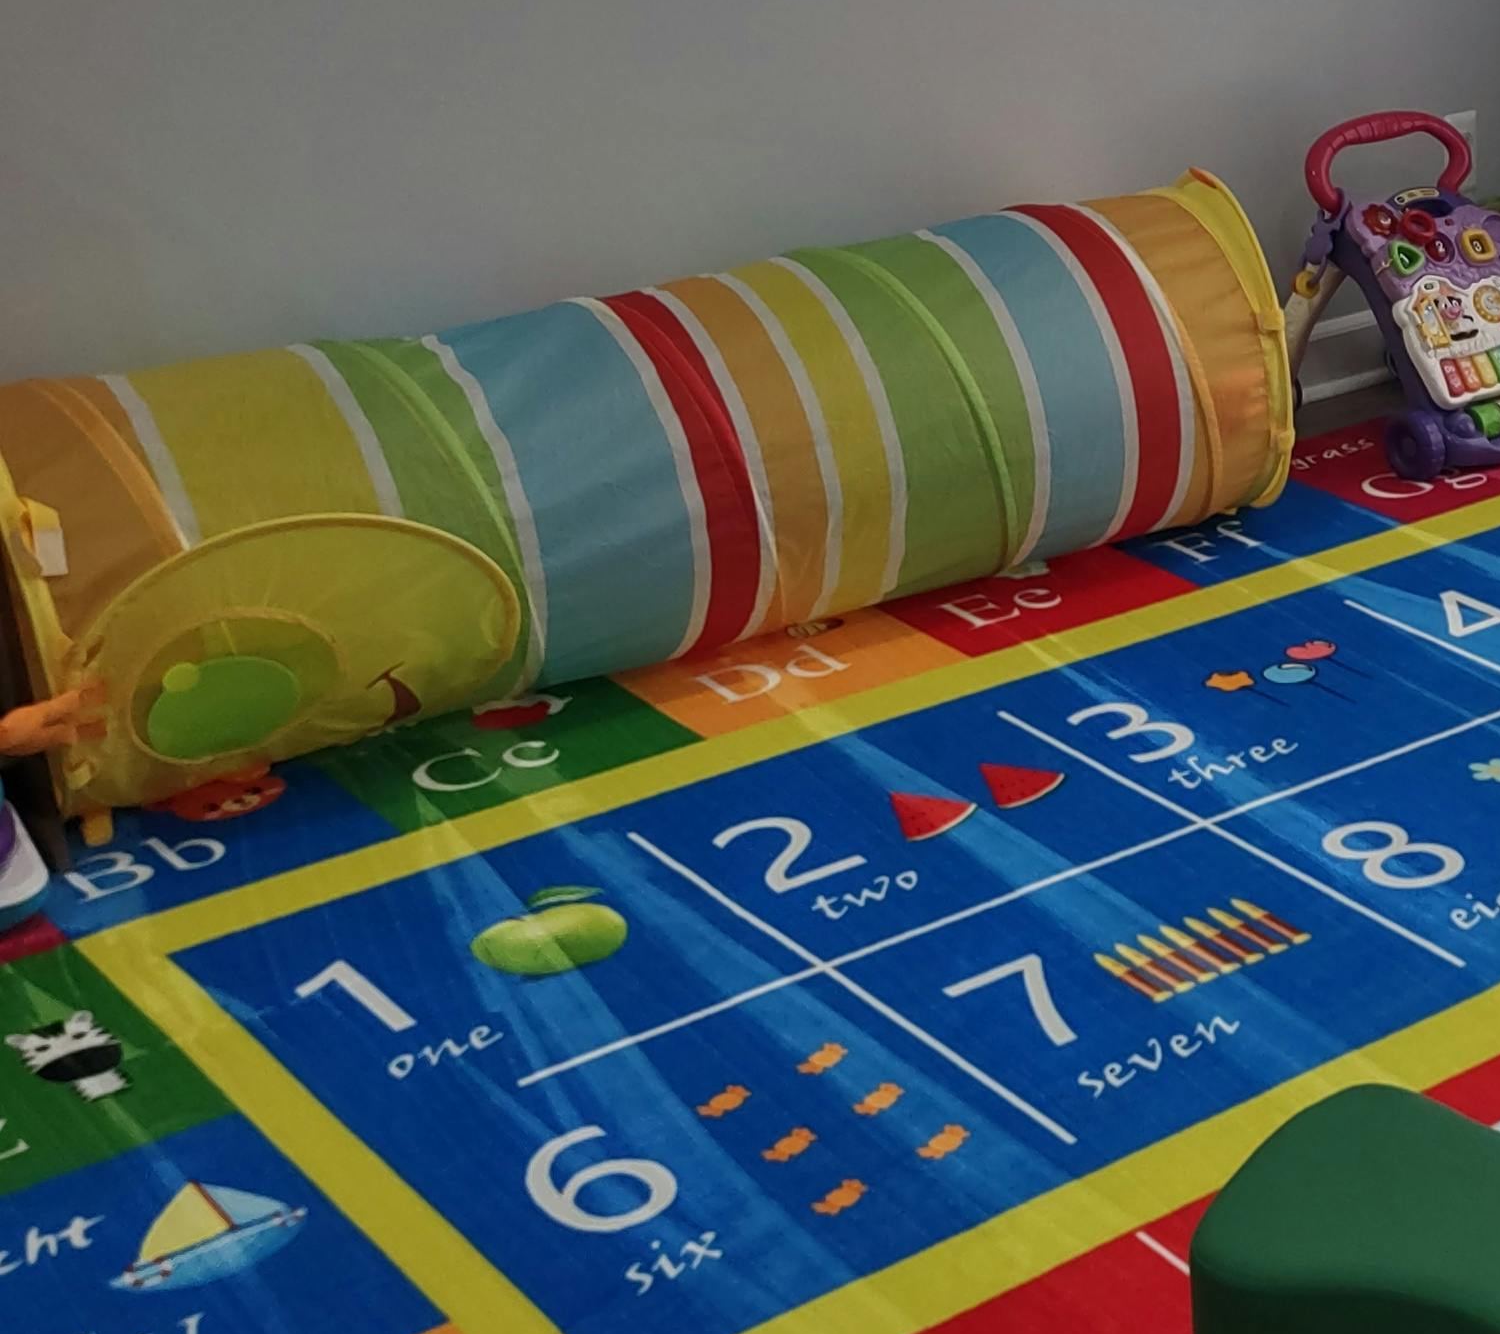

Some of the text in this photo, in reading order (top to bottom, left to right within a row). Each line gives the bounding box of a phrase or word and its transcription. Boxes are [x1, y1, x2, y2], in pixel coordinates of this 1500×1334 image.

[1292, 439, 1375, 470] grass
[1157, 521, 1262, 565] Ff
[934, 583, 1063, 631] Ee
[698, 646, 848, 702] Dd
[1067, 702, 1197, 764] 3
[1168, 734, 1299, 792] three
[413, 741, 559, 791] Cc
[64, 839, 225, 900] Bb
[711, 817, 868, 895] 2
[1321, 821, 1466, 889] 8
[811, 869, 919, 921] two
[296, 960, 416, 1031] 1
[943, 954, 1077, 1048] 7
[387, 1023, 502, 1078] one
[1078, 1014, 1240, 1098] seven
[526, 1126, 677, 1232] 6
[624, 1230, 723, 1294] six
